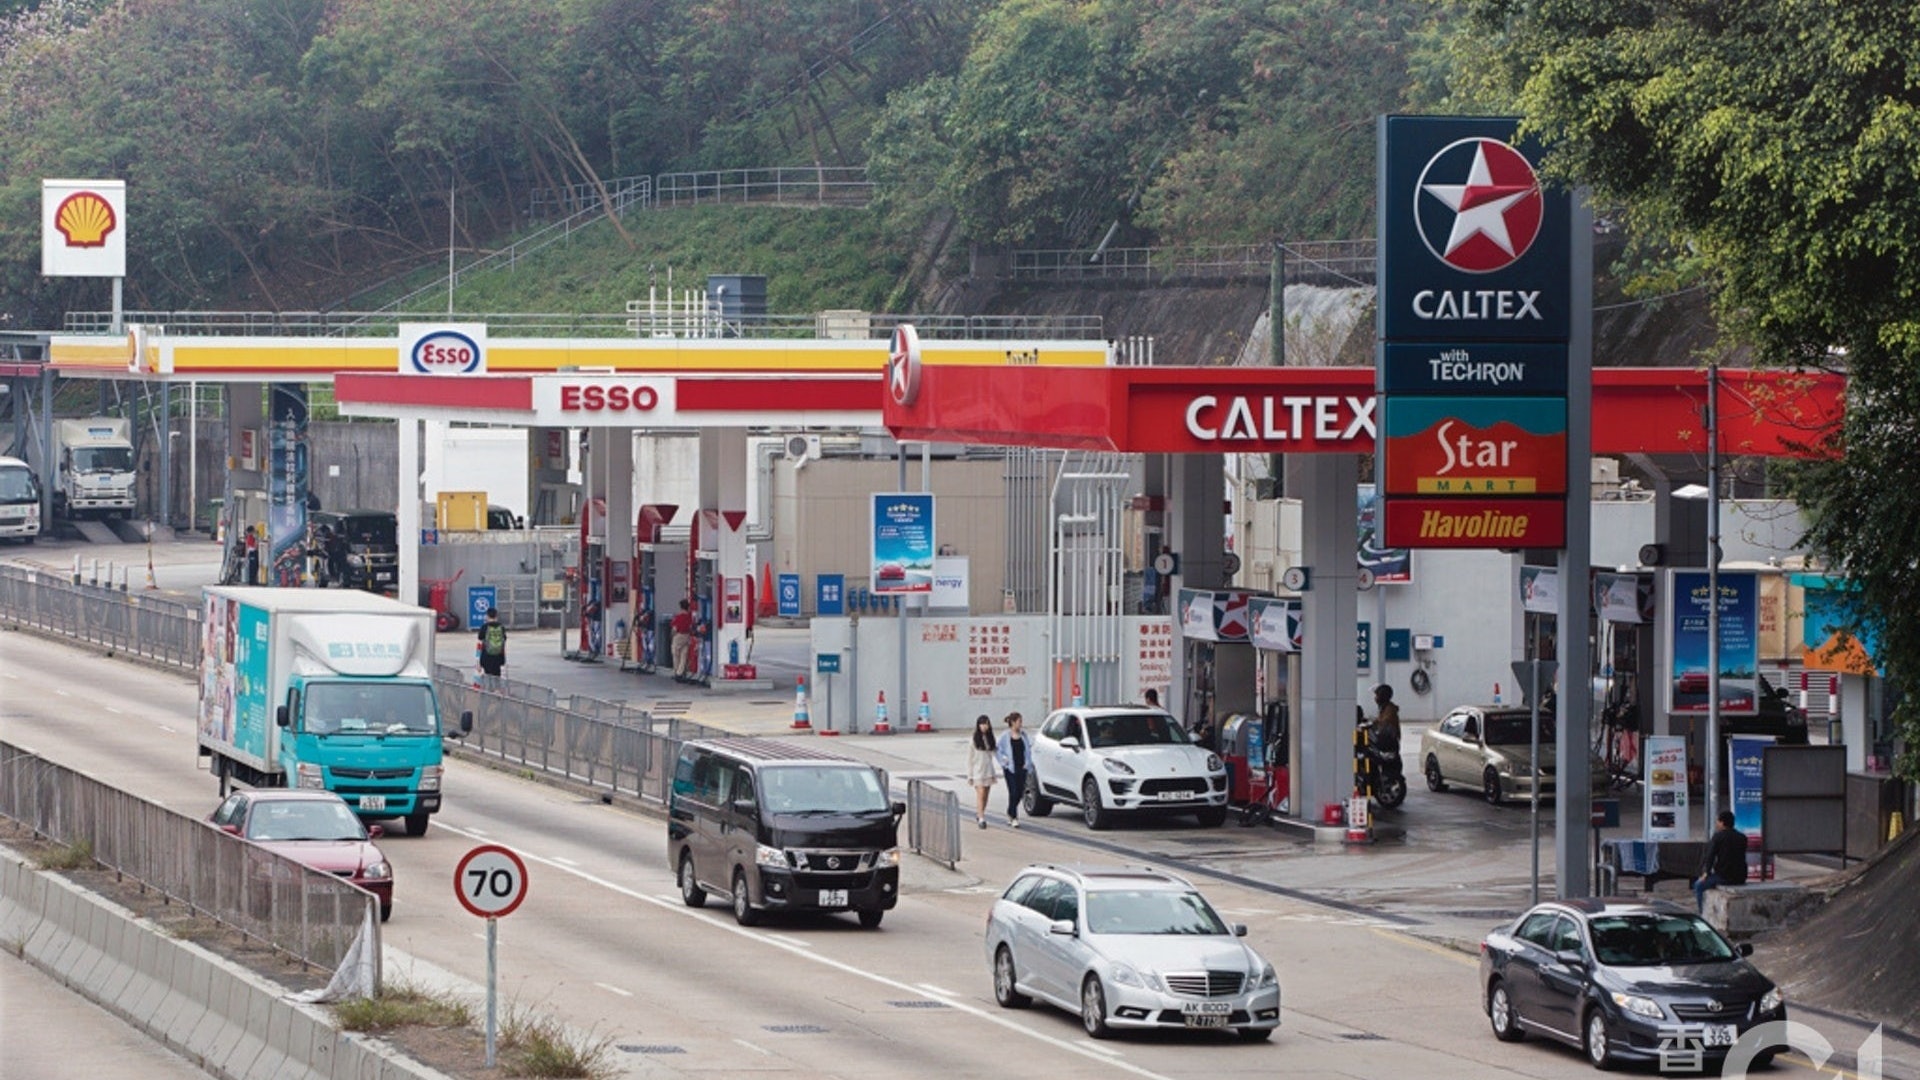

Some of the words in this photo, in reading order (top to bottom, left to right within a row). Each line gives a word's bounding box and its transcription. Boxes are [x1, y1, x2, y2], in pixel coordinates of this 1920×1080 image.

[1412, 290, 1543, 320] CALTEX
[423, 344, 471, 364] Esso
[1440, 349, 1469, 362] with
[1429, 359, 1524, 385] TECHRON
[561, 386, 659, 411] ESSO
[1186, 395, 1376, 440] CALTEX
[1436, 420, 1518, 475] Star
[1436, 480, 1517, 491] MART
[1419, 510, 1529, 538] Havoline
[1161, 559, 1168, 569] 1
[1291, 574, 1299, 584] 3
[969, 657, 978, 665] NO
[980, 657, 1010, 665] SMOKING
[969, 667, 978, 675] NO
[980, 667, 1001, 675] NAKED
[1003, 666, 1026, 675] LIGHTS
[969, 678, 994, 686] SWITCH
[969, 687, 992, 696] ENGINE
[468, 868, 513, 897] 70
[1184, 1003, 1199, 1012] AK
